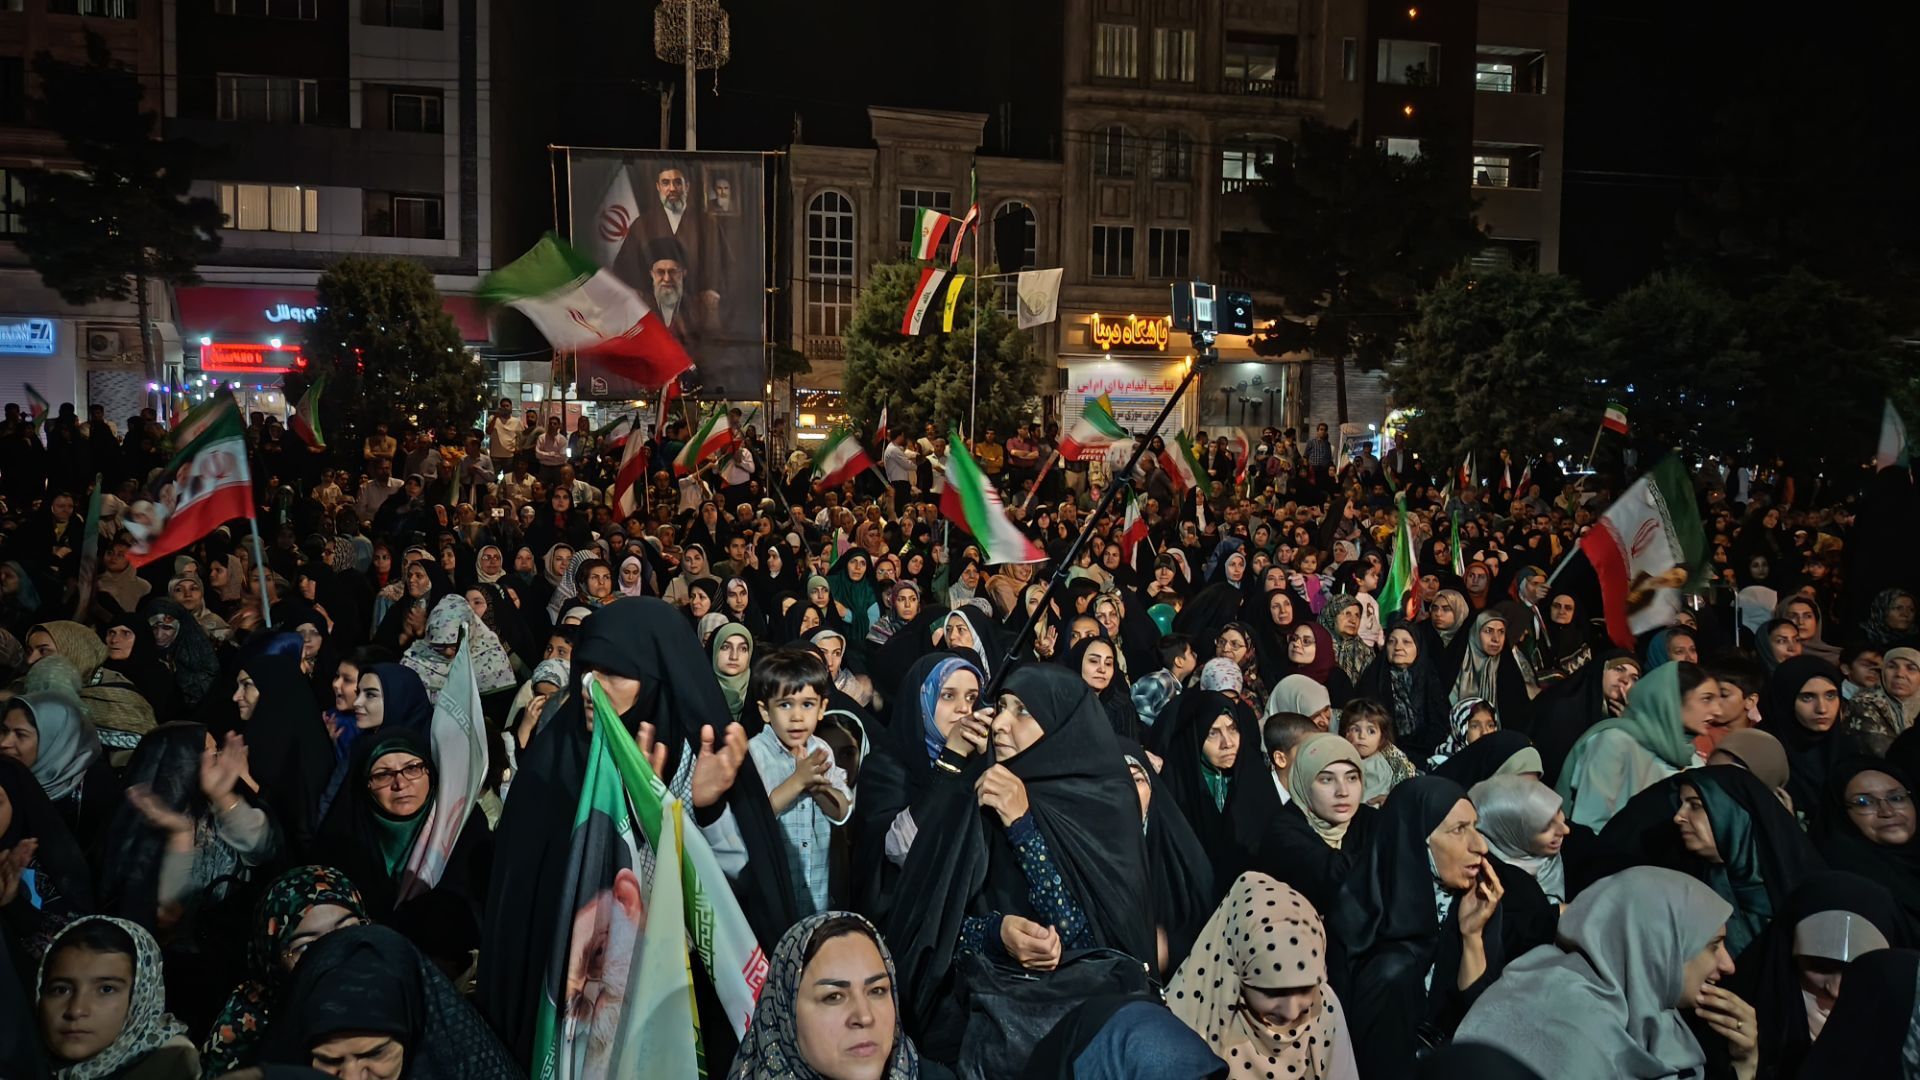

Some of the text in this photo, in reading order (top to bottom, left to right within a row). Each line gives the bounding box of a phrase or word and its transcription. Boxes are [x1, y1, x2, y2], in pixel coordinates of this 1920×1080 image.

[1122, 318, 1168, 351] باشگاه
[1117, 379, 1124, 394] با
[1125, 379, 1147, 394] اندام
[1149, 379, 1175, 395] تناسب
